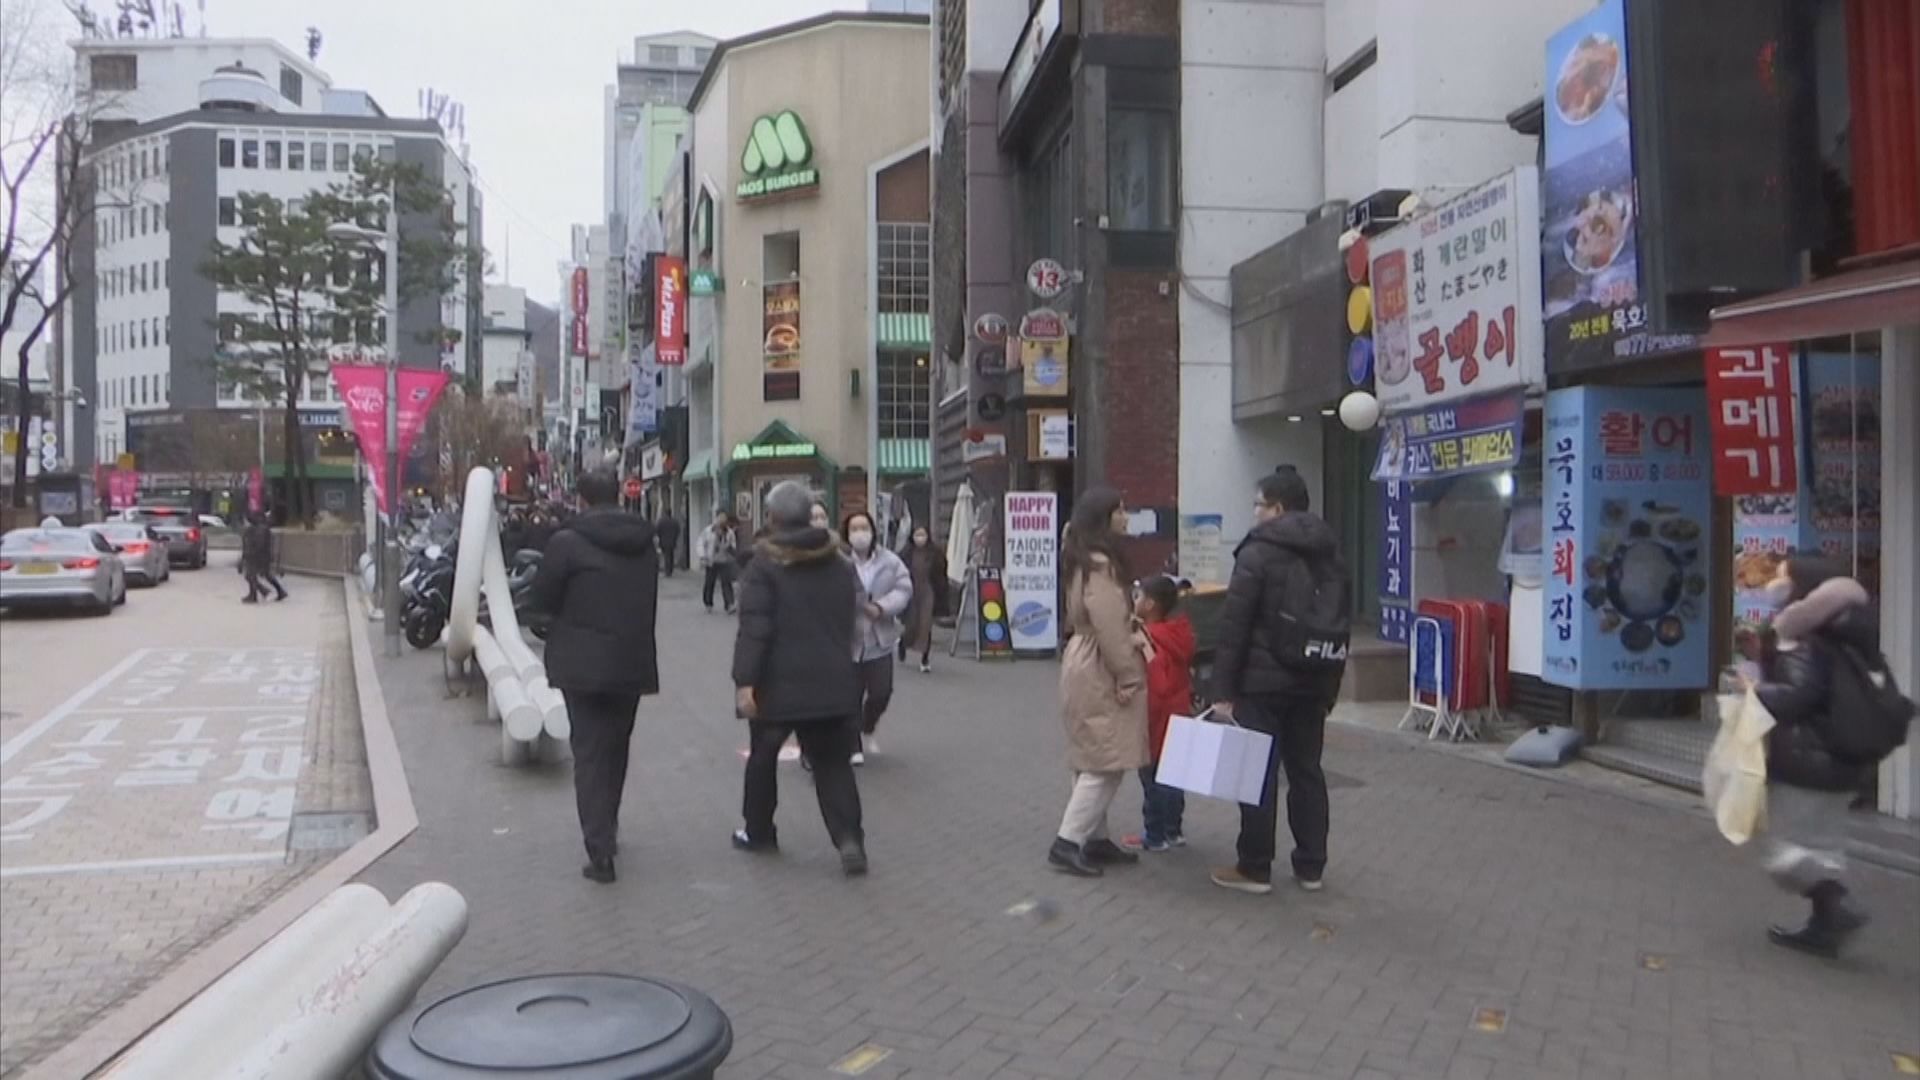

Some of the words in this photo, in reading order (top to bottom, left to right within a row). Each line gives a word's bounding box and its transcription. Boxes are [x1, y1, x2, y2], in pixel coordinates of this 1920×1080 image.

[736, 179, 764, 196] MOS
[765, 169, 816, 191] BURGER
[1437, 216, 1507, 267] 계란말이
[1036, 270, 1060, 289] 13
[1440, 256, 1508, 303] たまごやき
[1412, 304, 1516, 395] 골뱅이
[1599, 411, 1693, 456] 활어
[1718, 345, 1782, 489] 과메기
[752, 446, 774, 458] MOS
[775, 444, 816, 457] BURGER
[1008, 497, 1054, 512] HAPPY
[1012, 515, 1050, 530] HOUR
[1387, 481, 1401, 596] 비뇨기과
[1304, 640, 1347, 660] FILA
